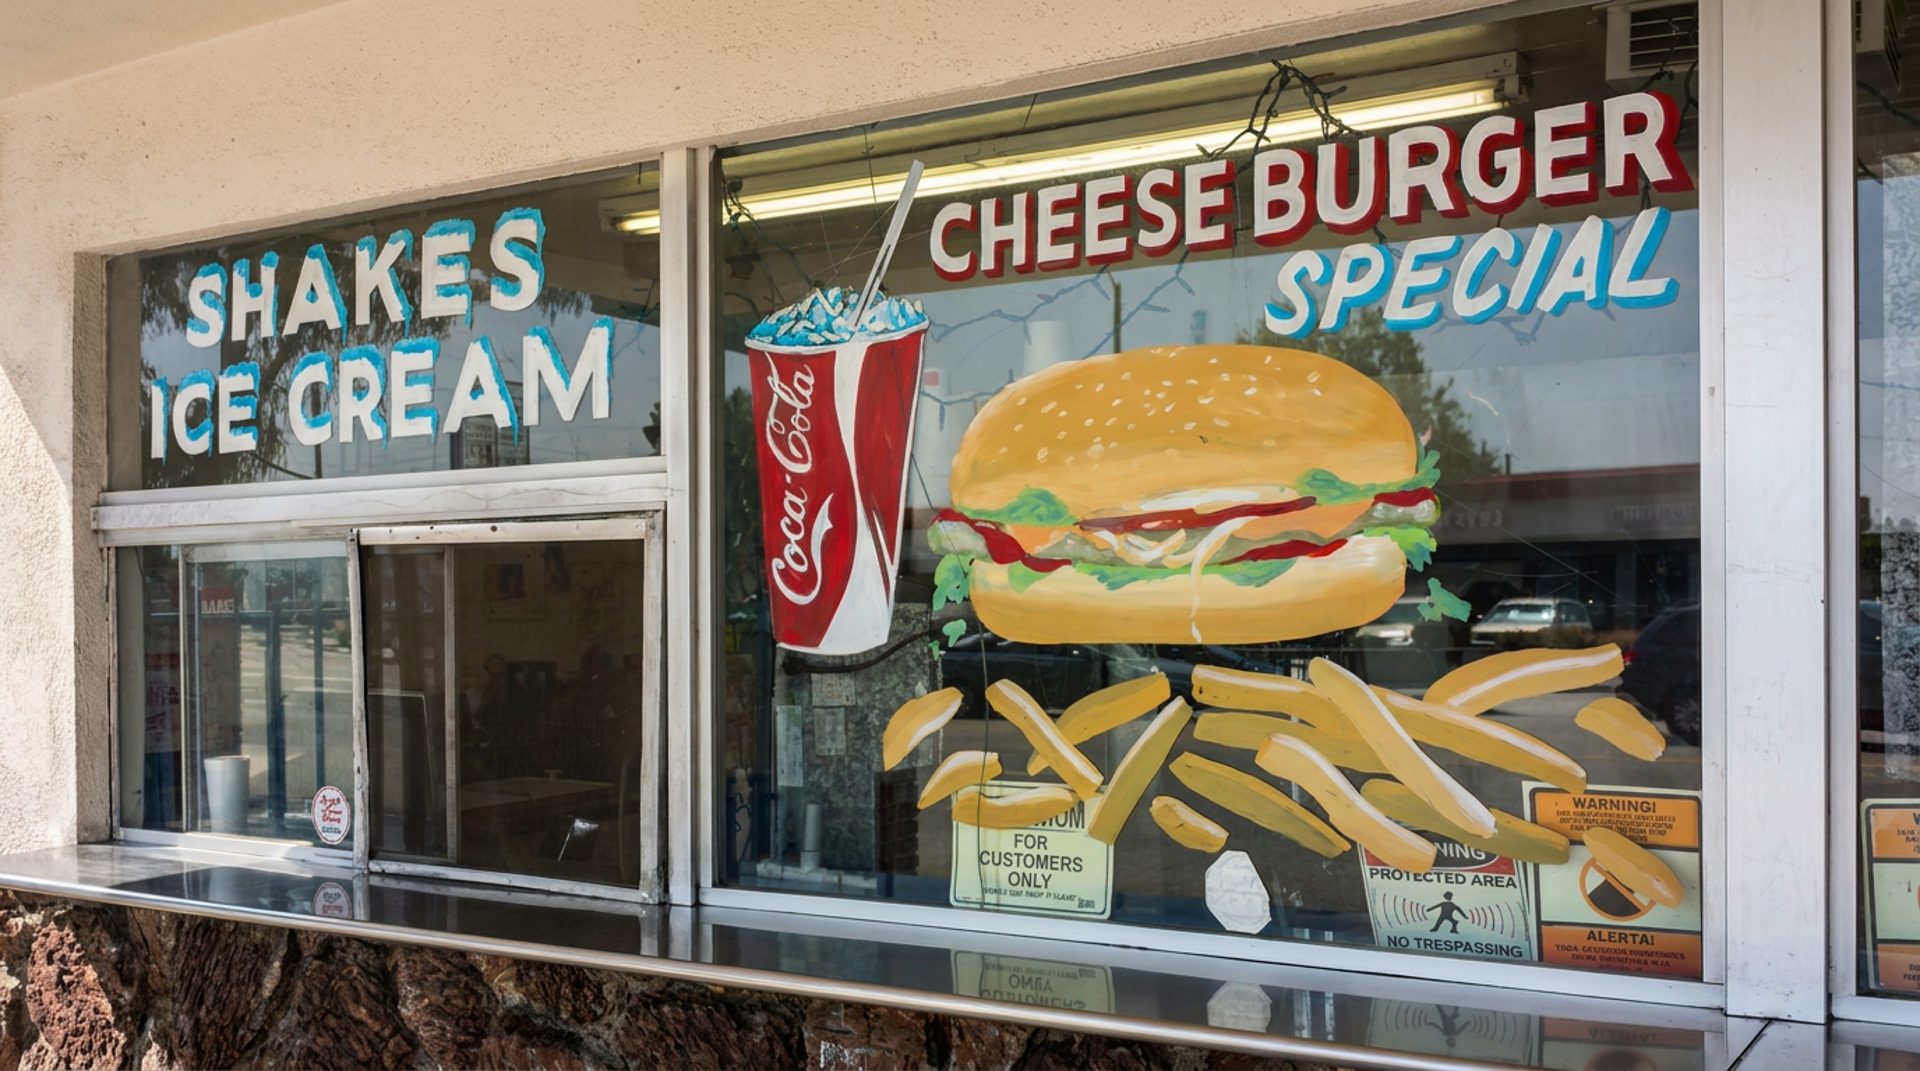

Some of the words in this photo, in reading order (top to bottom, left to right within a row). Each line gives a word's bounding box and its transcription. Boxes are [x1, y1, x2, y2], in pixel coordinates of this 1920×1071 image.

[929, 159, 1236, 281] CHEESE
[1253, 91, 1695, 247] BURGER
[186, 206, 546, 348] SHAKES
[1264, 206, 1680, 340] SPECIAL
[151, 361, 261, 466] ICE
[288, 316, 615, 449] CREAM
[765, 350, 834, 606] Coca-Cola
[1572, 797, 1656, 813] WARNING!
[1014, 833, 1048, 850] FOR
[980, 850, 1083, 873] CUSTOMERS
[1008, 871, 1052, 889] ONLY
[1369, 867, 1467, 885] PROTECTED
[1471, 874, 1518, 889] AREA
[1387, 935, 1410, 948] NO
[1414, 937, 1524, 958] TRESPASSING
[1586, 930, 1655, 946] ALERTA!
